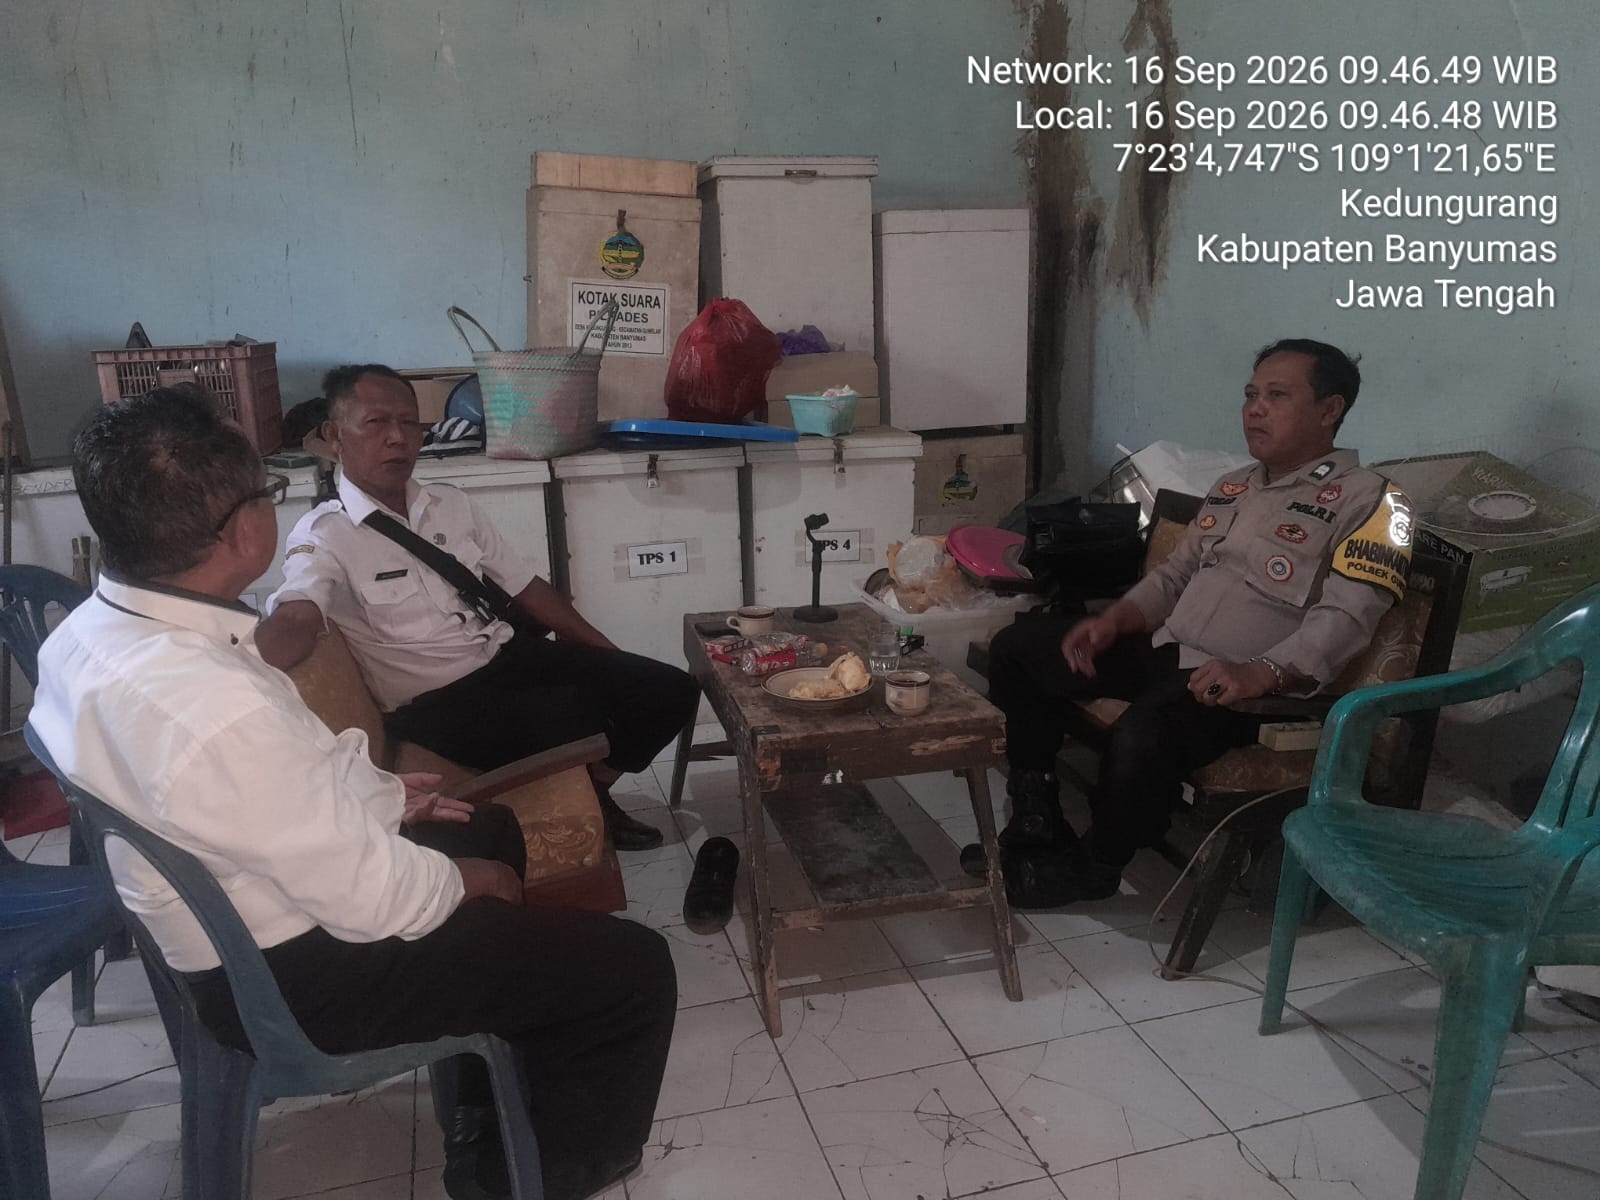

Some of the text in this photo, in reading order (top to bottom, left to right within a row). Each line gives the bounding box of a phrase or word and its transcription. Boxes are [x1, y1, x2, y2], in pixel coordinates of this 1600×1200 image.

[578, 291, 660, 309] KOTAK SUARA
[1286, 501, 1337, 524] POLRI
[842, 539, 851, 551] 4
[1440, 544, 1465, 564] PAN
[637, 551, 677, 566] TPS 1
